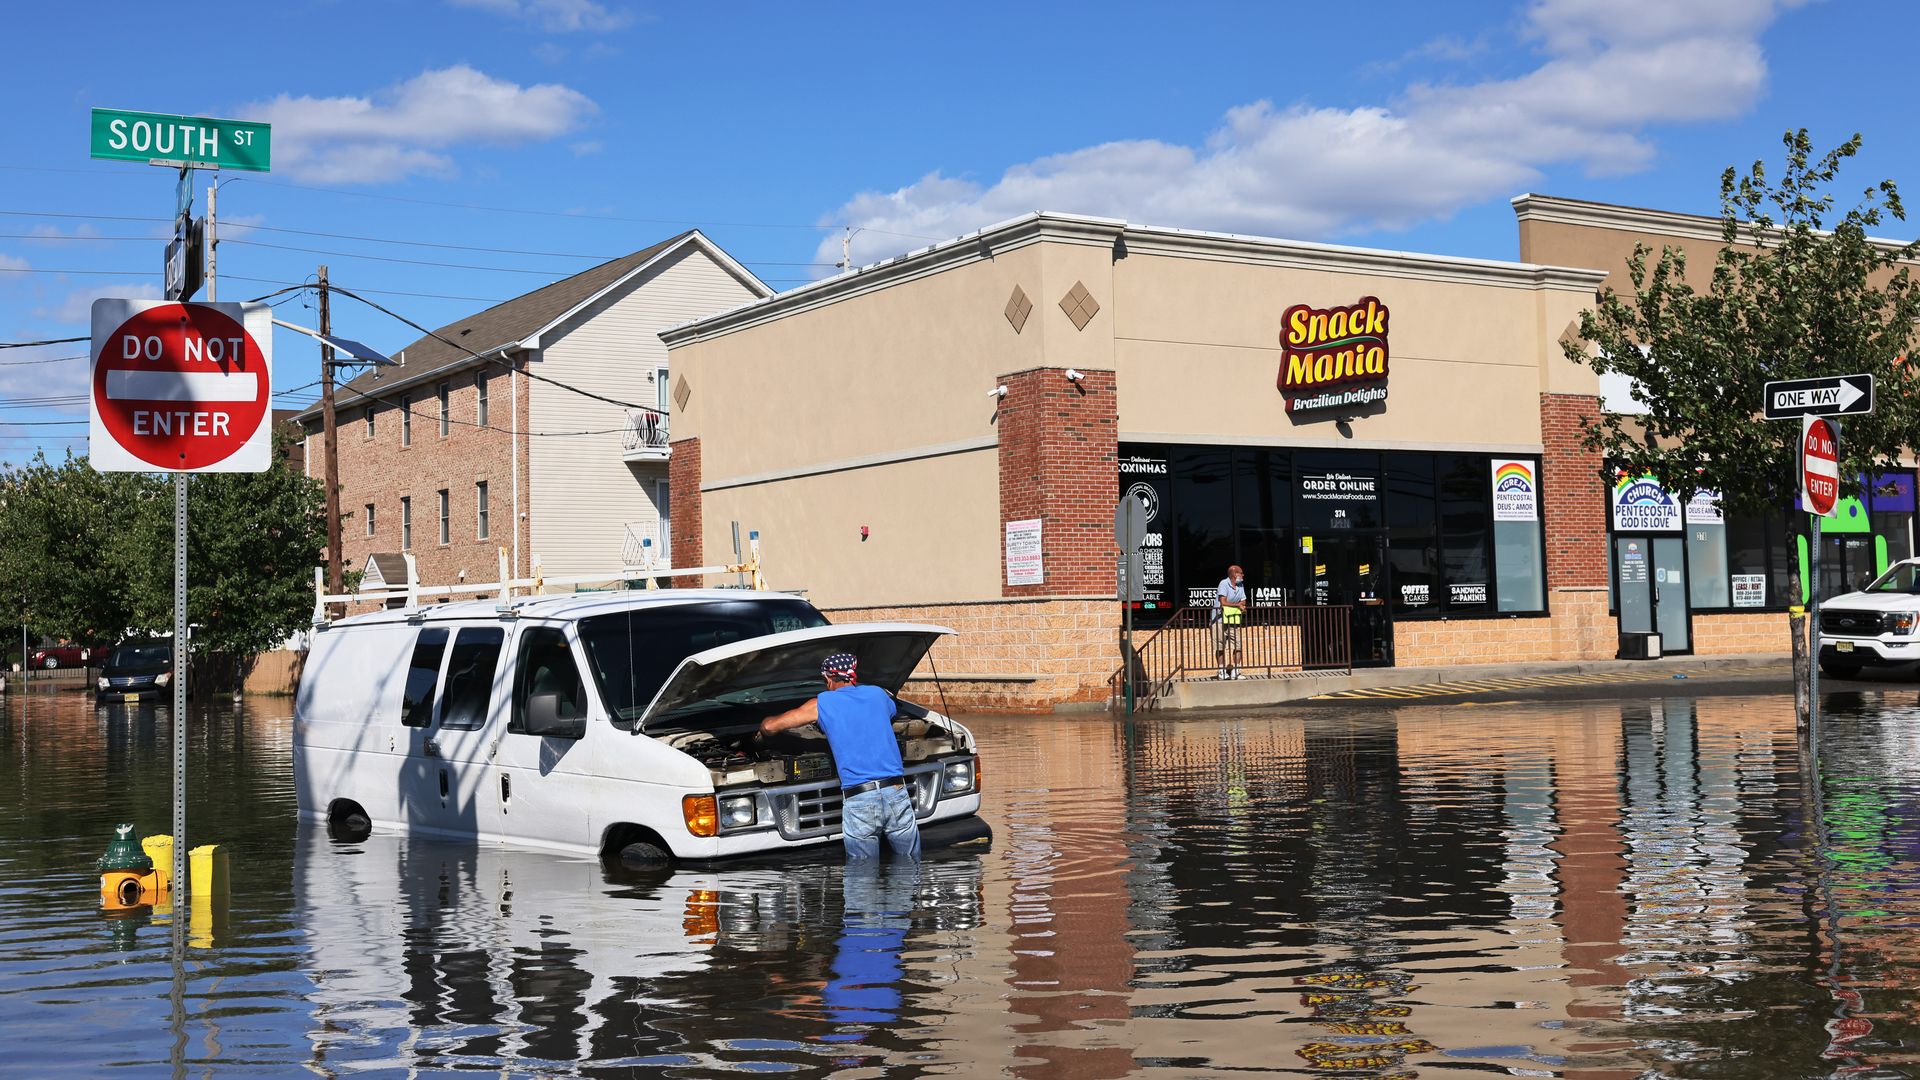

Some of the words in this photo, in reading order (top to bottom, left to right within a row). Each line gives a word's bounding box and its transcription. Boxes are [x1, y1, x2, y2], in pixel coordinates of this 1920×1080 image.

[108, 119, 219, 158] SOUTH
[234, 130, 254, 146] ST
[1288, 301, 1385, 344] Snack
[122, 334, 163, 361] DO
[184, 336, 244, 362] NOT
[1286, 344, 1385, 385] Mania
[1293, 393, 1342, 411] Brazilian
[1343, 388, 1387, 404] Delights
[1777, 392, 1806, 407] ONE
[1810, 388, 1840, 404] WAY
[133, 410, 230, 436] ENTER
[1808, 435, 1818, 451] DO
[1822, 438, 1837, 456] NOT
[1303, 480, 1336, 490] ORDER
[1340, 481, 1375, 491] ONLINE
[1501, 478, 1526, 491] IGREJA
[1810, 478, 1833, 497] ENTER
[1627, 485, 1664, 504] CHURCH
[1334, 510, 1346, 518] 374
[1615, 505, 1678, 517] PENTECOSTAL
[1621, 517, 1639, 528] GOD
[1641, 518, 1648, 528] IS
[1650, 517, 1670, 528] LOVE
[1189, 590, 1217, 598] JUICES
[1256, 588, 1281, 600] AÇAI
[1401, 585, 1429, 594] COFFEE
